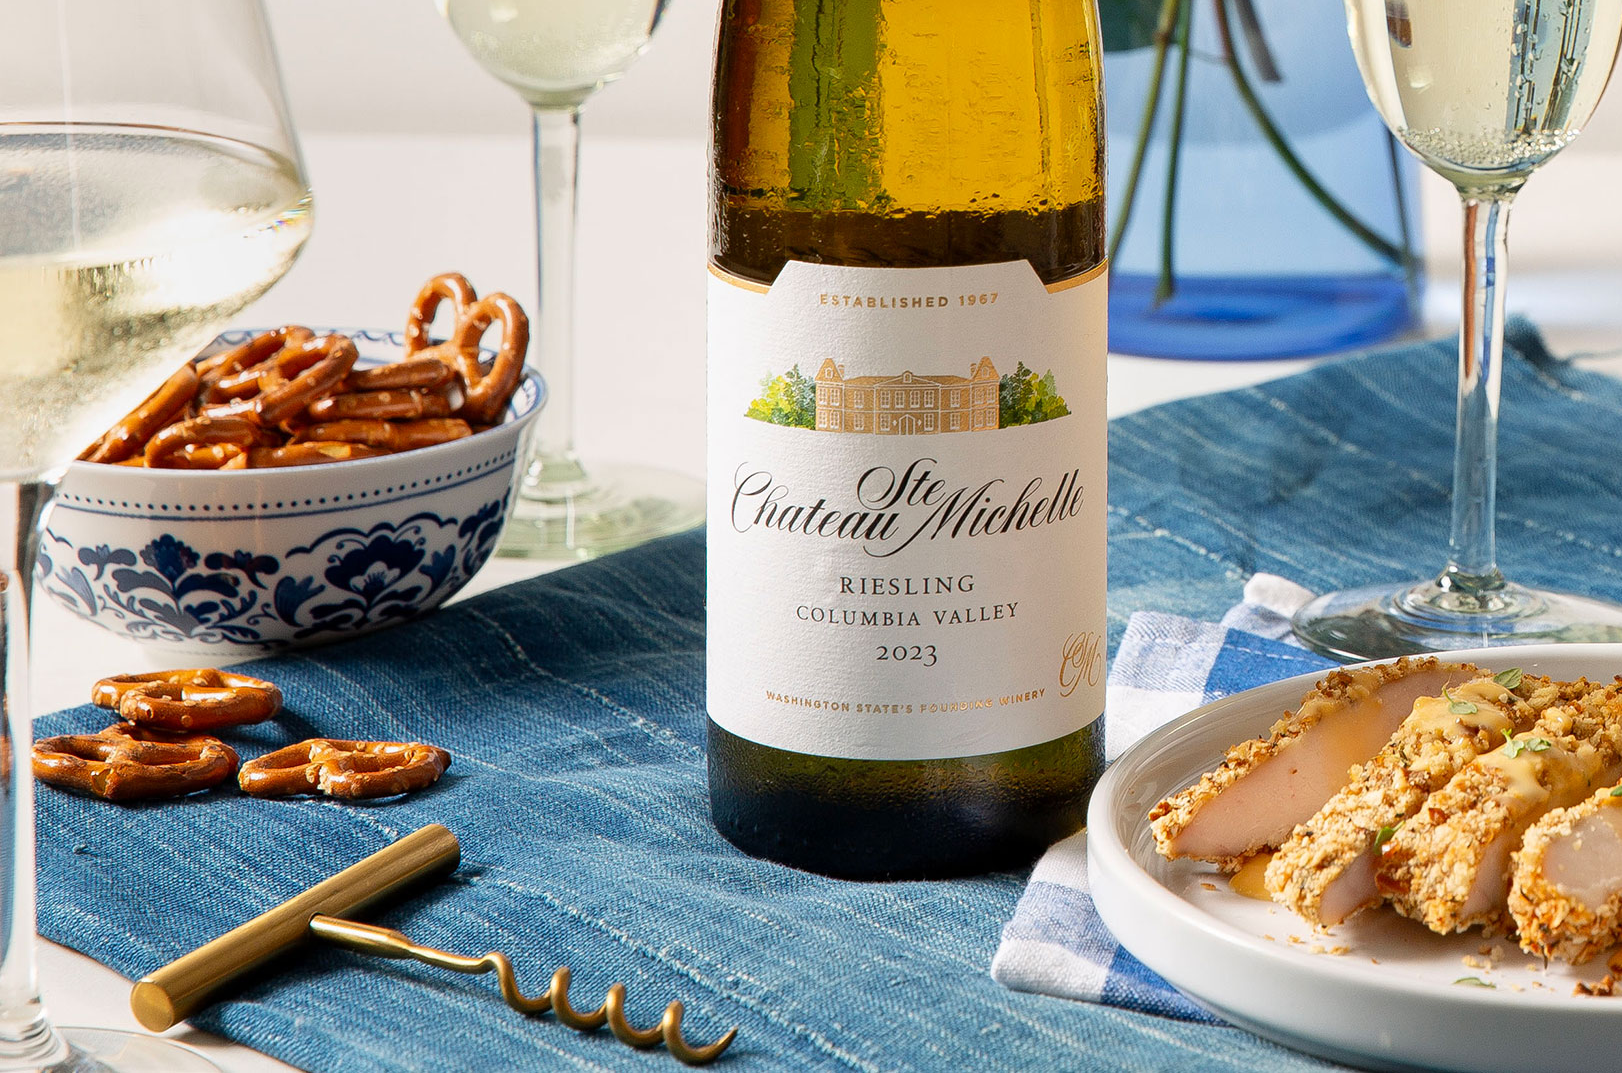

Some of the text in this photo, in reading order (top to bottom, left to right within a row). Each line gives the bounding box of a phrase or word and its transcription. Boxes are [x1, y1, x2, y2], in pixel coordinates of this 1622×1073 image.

[820, 292, 999, 308] ESTABLISHED 1967
[731, 458, 1084, 558] Chateau Ste Michelle
[840, 574, 976, 595] RIESLING
[796, 602, 1019, 626] COLUMBIA VALLEY
[876, 645, 938, 666] 2023
[766, 690, 851, 711] WASHINGTON
[919, 698, 994, 714] FOUNDING
[999, 688, 1046, 707] WINERY
